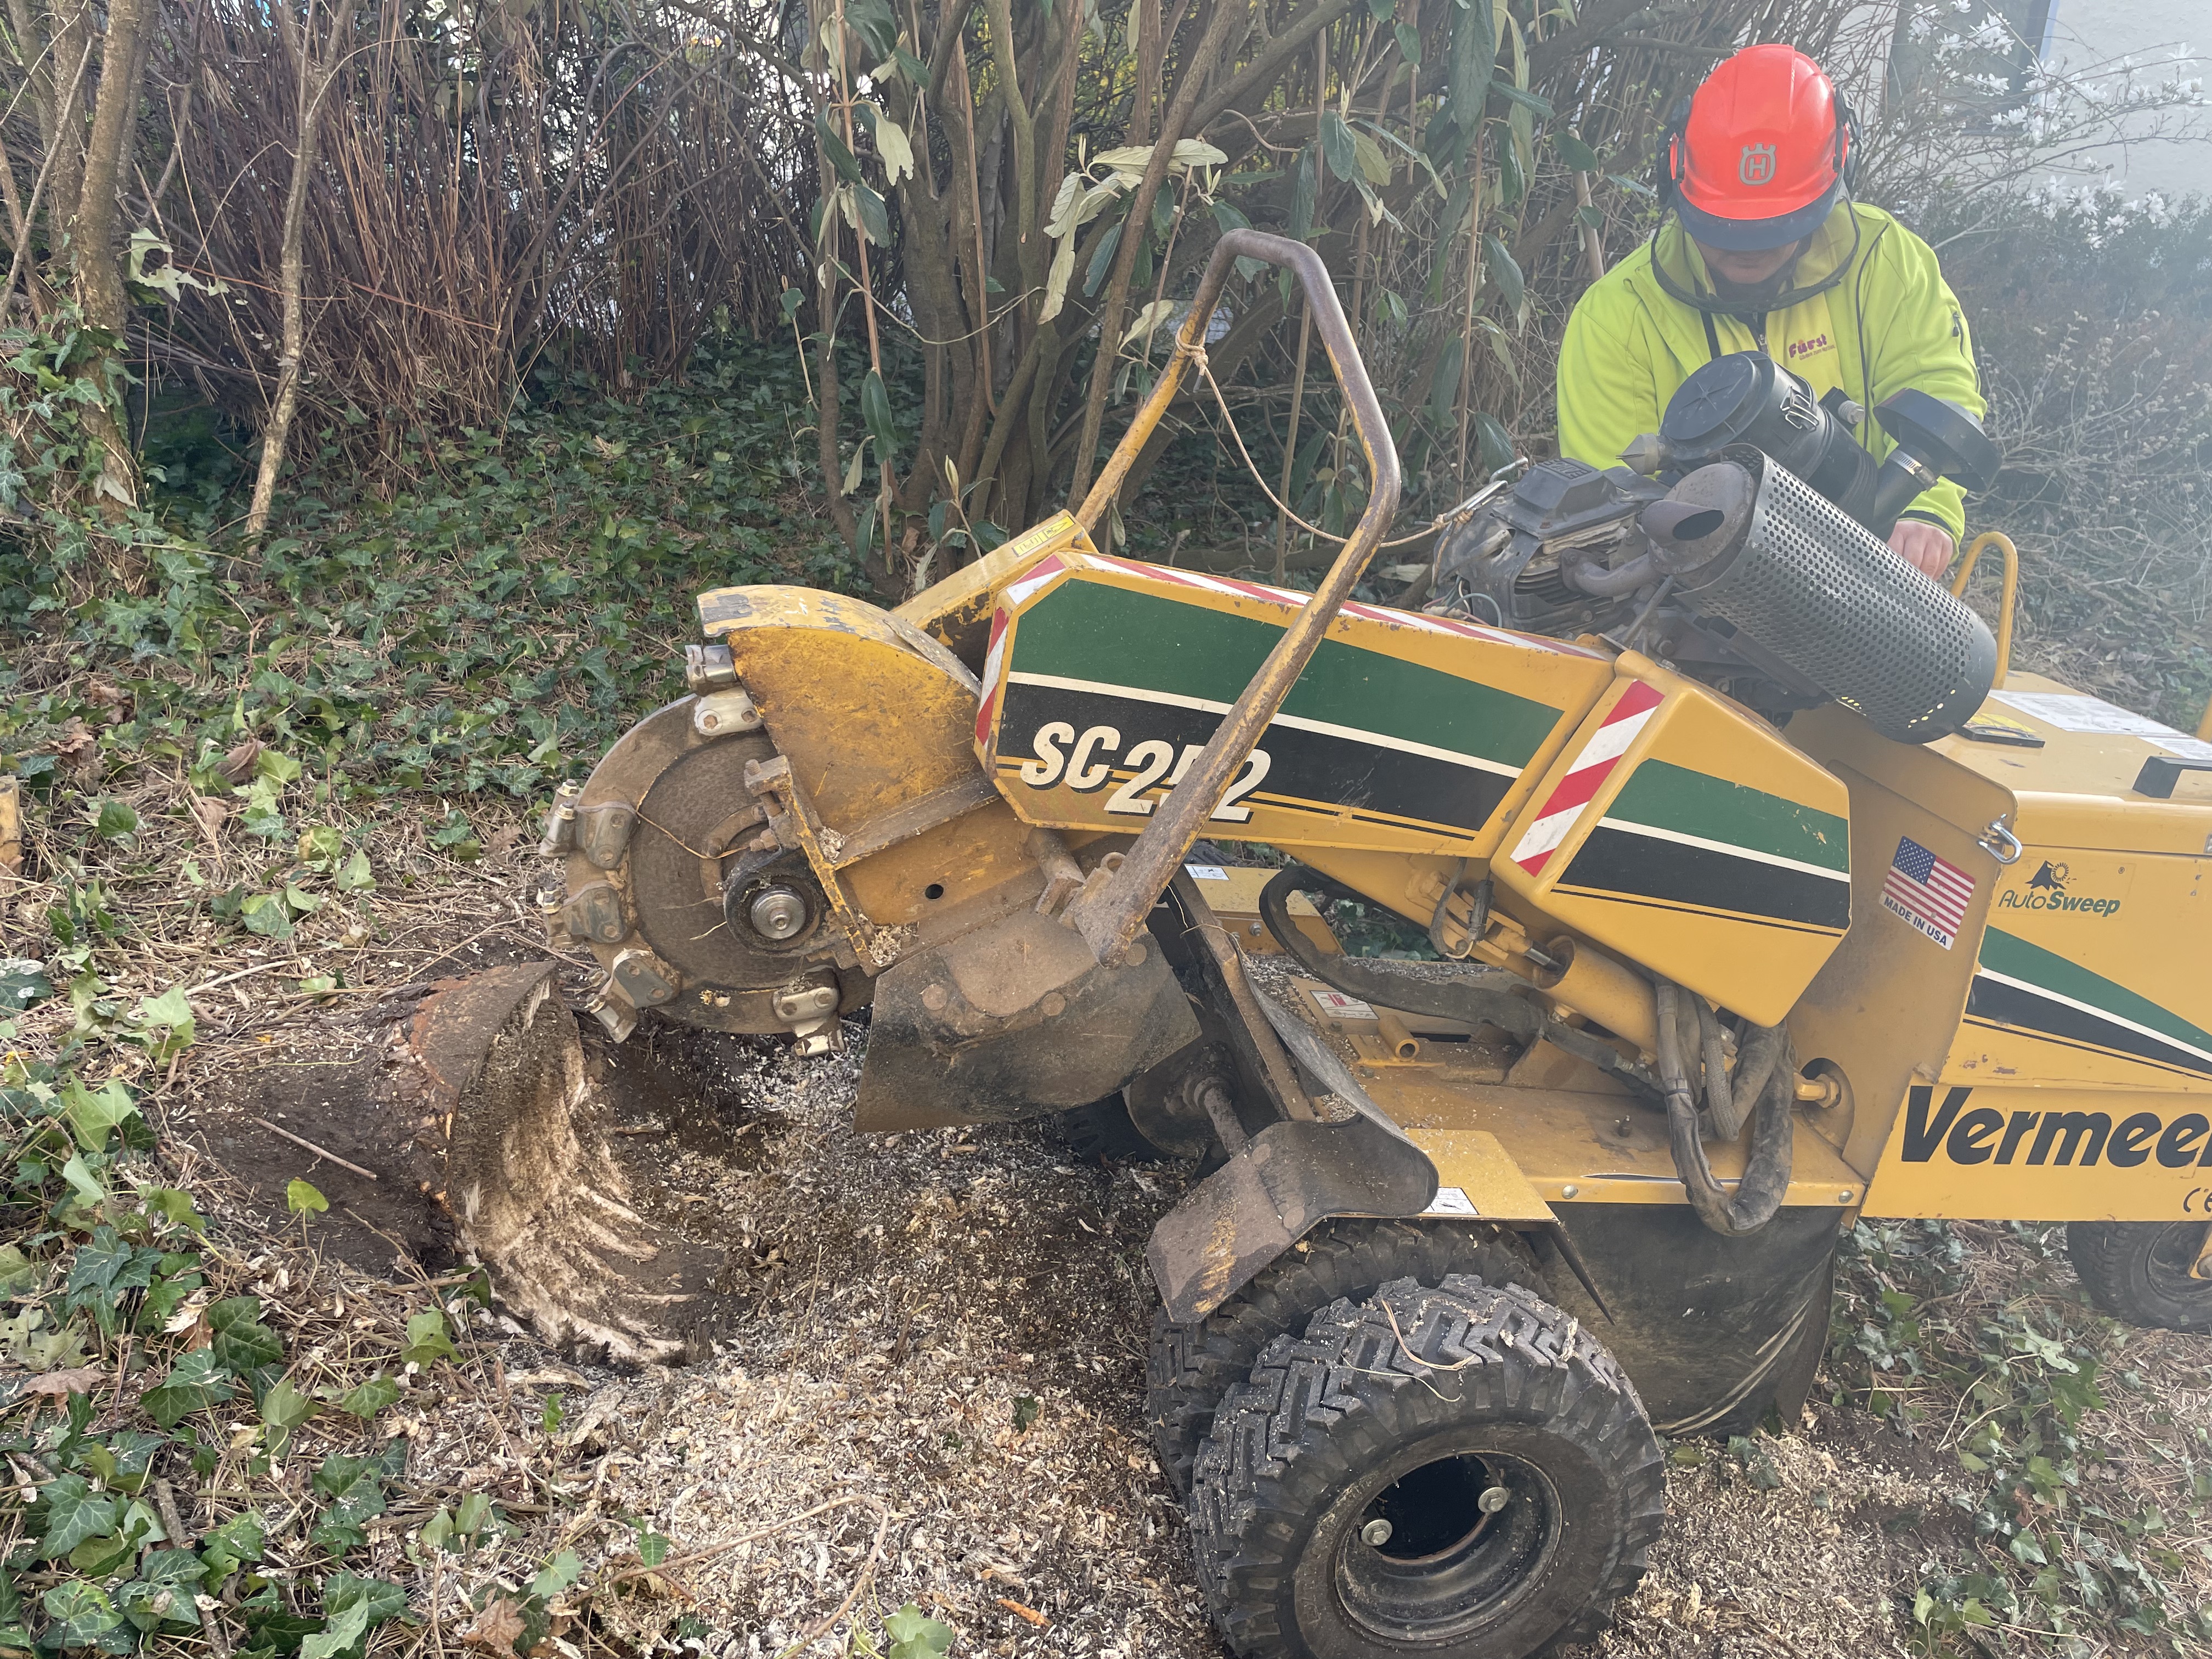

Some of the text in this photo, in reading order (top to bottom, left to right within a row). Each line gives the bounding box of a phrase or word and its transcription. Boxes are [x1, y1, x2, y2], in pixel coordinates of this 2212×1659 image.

[1884, 896, 1947, 946] MADE IN USA
[1998, 889, 2121, 917] AutoSweep
